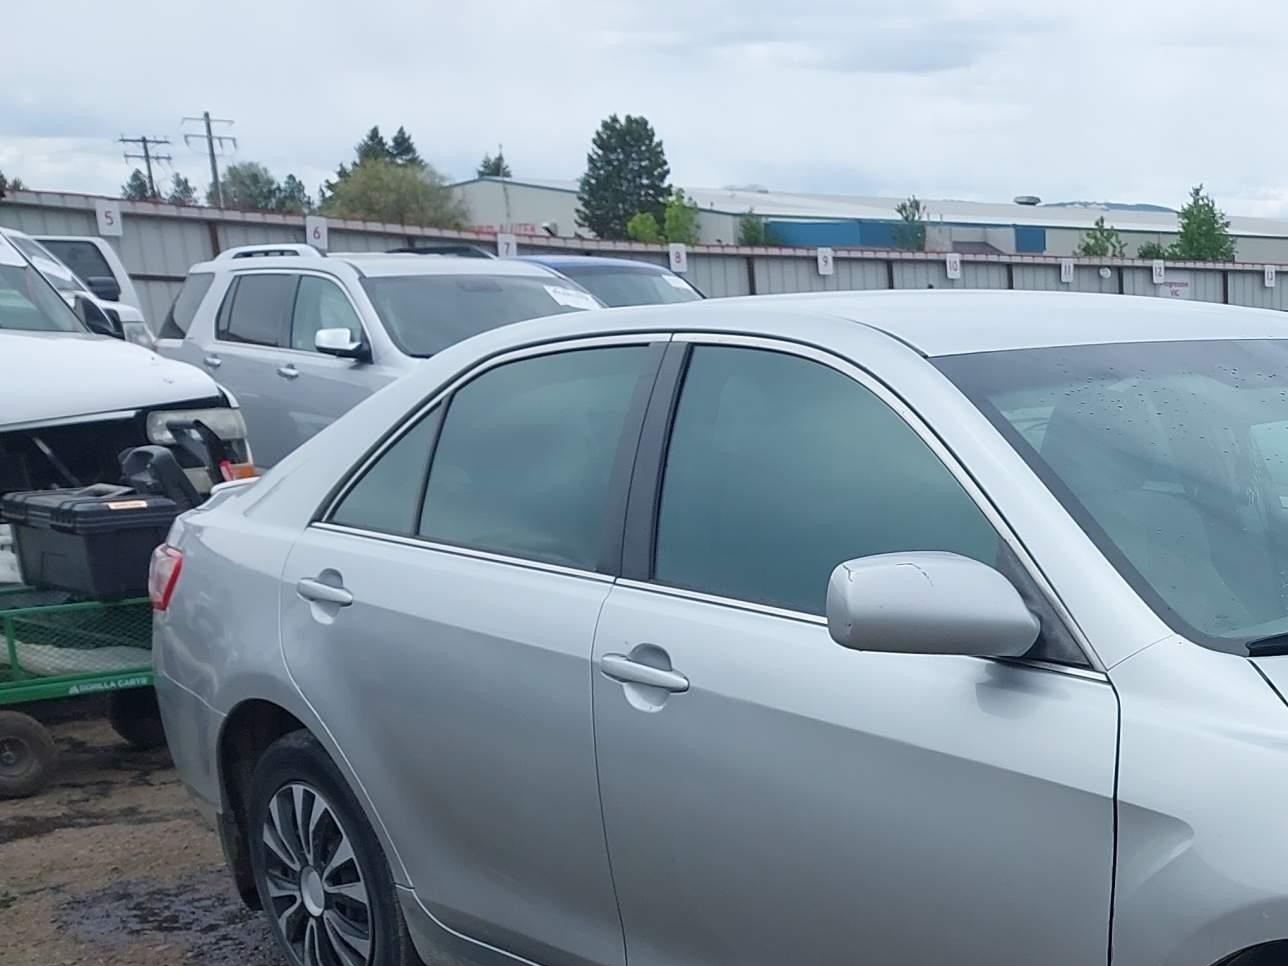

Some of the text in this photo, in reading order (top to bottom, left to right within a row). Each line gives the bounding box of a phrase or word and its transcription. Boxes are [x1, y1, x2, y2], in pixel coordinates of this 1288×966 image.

[104, 210, 114, 225] 5
[312, 225, 321, 240] 6
[503, 241, 511, 256] 7
[674, 251, 682, 264] 8
[822, 254, 829, 267] 9
[948, 259, 959, 273] 10
[1062, 263, 1072, 277] 11
[1154, 266, 1163, 278] 12
